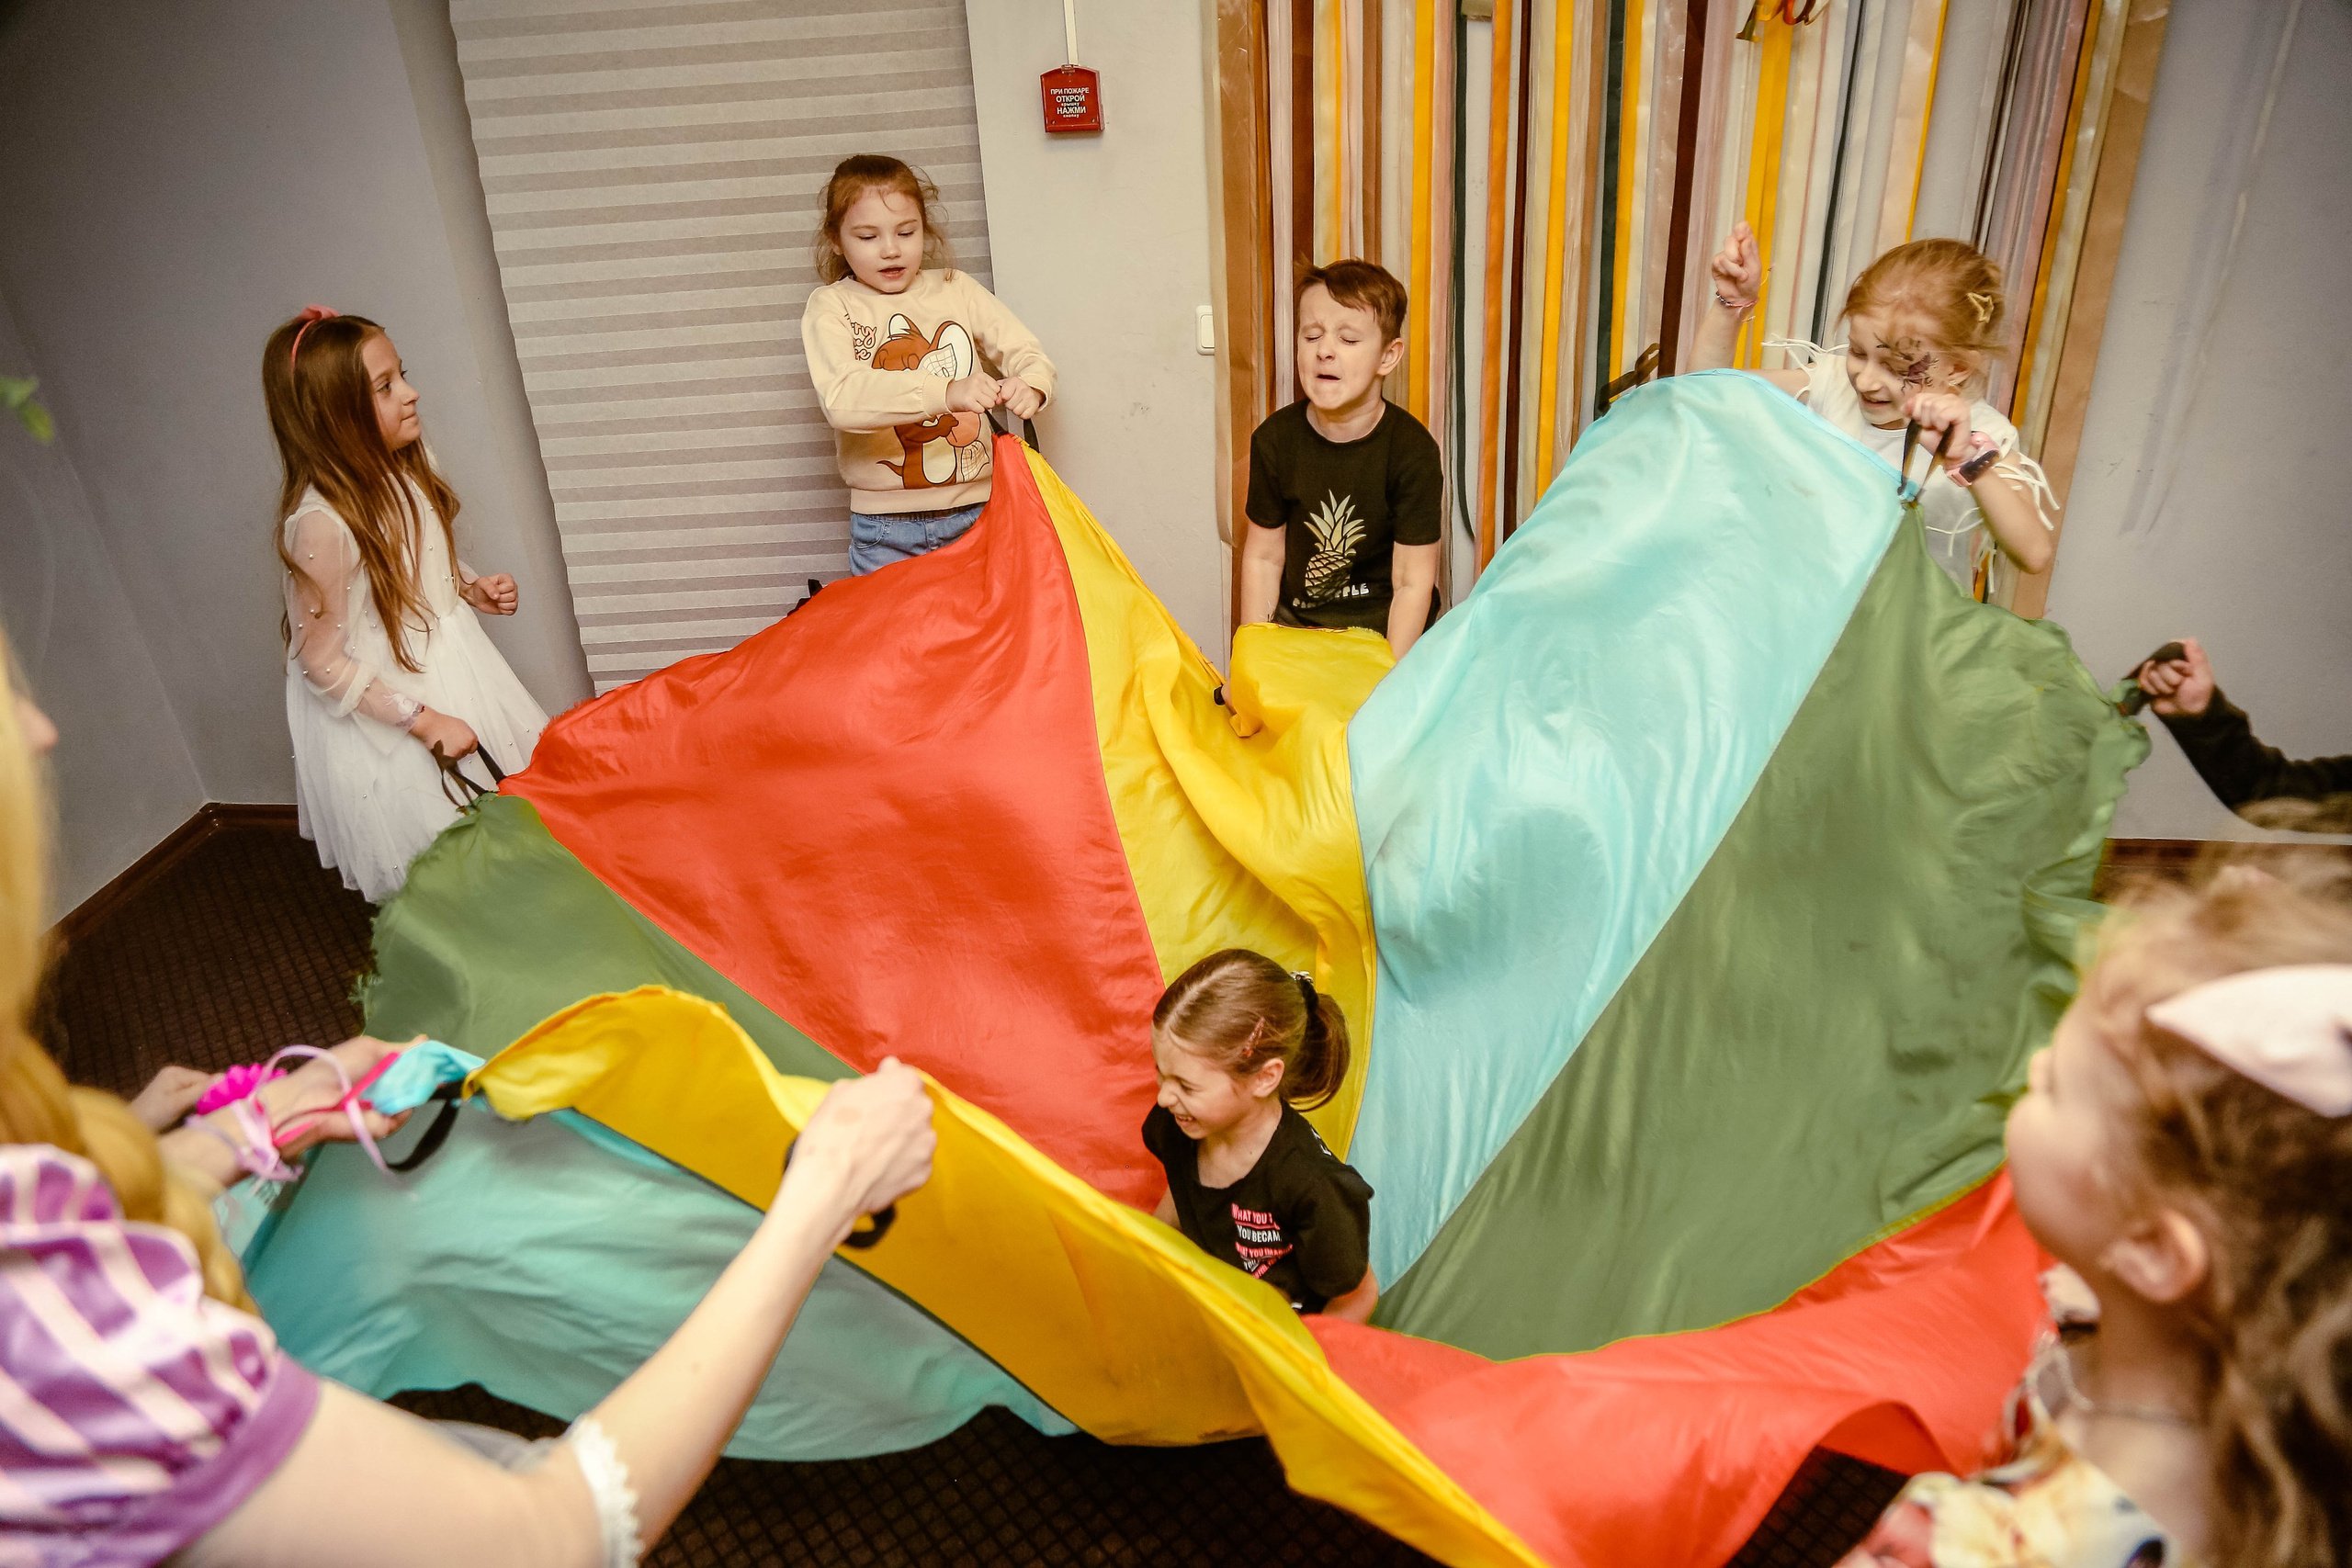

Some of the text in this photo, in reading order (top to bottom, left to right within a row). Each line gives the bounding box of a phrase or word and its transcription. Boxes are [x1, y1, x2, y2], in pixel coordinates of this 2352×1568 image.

[1056, 93, 1085, 103] ОТКРОЙ
[1057, 107, 1086, 115] НАЖМИ
[1231, 1202, 1251, 1222] WHAT
[1252, 1211, 1268, 1224] YOU
[1237, 1224, 1282, 1243] YOU BECAM
[1249, 1248, 1264, 1258] YOU
